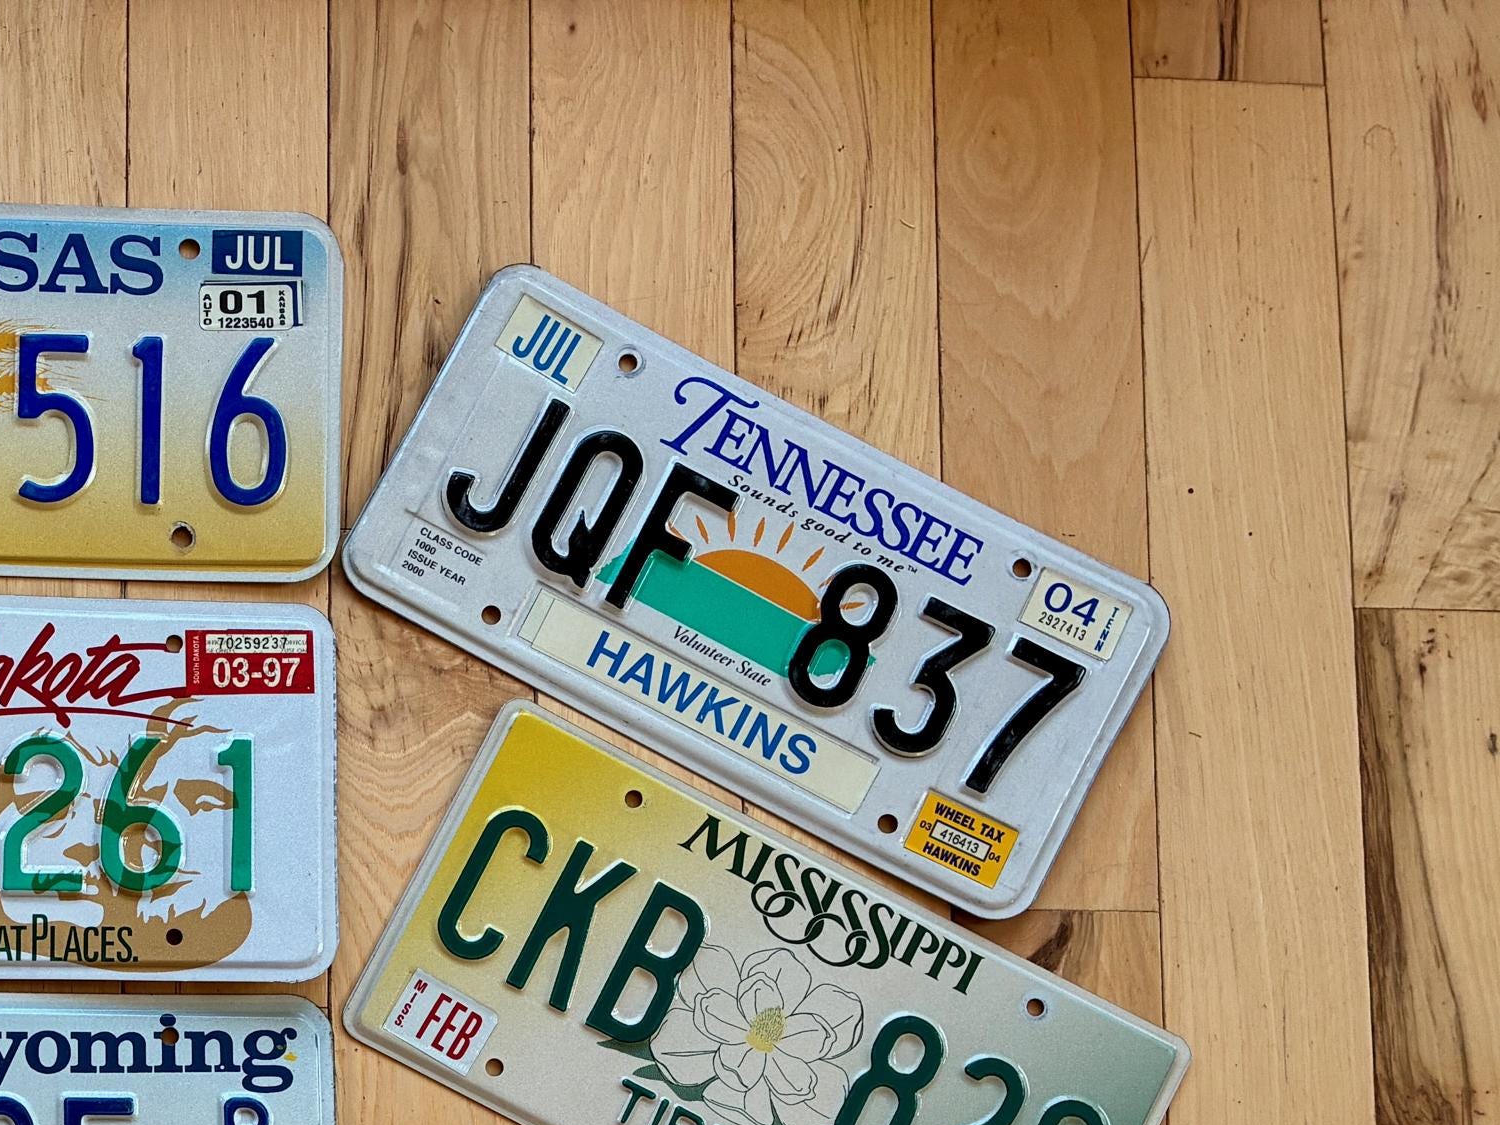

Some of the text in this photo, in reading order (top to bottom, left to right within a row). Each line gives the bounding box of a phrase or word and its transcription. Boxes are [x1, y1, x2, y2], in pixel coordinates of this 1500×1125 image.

[225, 235, 294, 270] JUL
[203, 294, 212, 325] AUTO
[220, 290, 265, 314] 01
[278, 290, 286, 326] KANSAS
[218, 317, 274, 328] 1223540
[512, 314, 582, 385] JUL
[16, 335, 290, 507] 516
[660, 376, 984, 586] TENNESSEE
[728, 474, 798, 518] Sounds
[800, 517, 856, 544] good
[852, 541, 871, 556] to
[415, 539, 436, 555] 1000
[420, 527, 483, 566] CLASS CODE
[401, 560, 425, 577] 2000
[408, 549, 466, 586] ISSUE YEAR
[441, 398, 1086, 793] JQF 837
[1044, 583, 1099, 627] 04
[217, 637, 288, 650] 70259237
[1038, 611, 1087, 641] 2927413
[1094, 607, 1119, 652] TENN
[192, 635, 200, 684] SOUTH DAKOTA
[212, 657, 300, 688] 03-97
[670, 625, 771, 687] Volunteer State
[586, 630, 817, 775] HAWKINS
[920, 820, 932, 831] 03
[935, 802, 1005, 843] WHEEL TAX
[940, 829, 979, 854] 416413
[923, 841, 981, 876] HAWKINS
[988, 852, 1001, 863] 04
[678, 813, 985, 995] MISSISSIPPI
[437, 809, 701, 1043] CKB
[416, 993, 483, 1060] FEB
